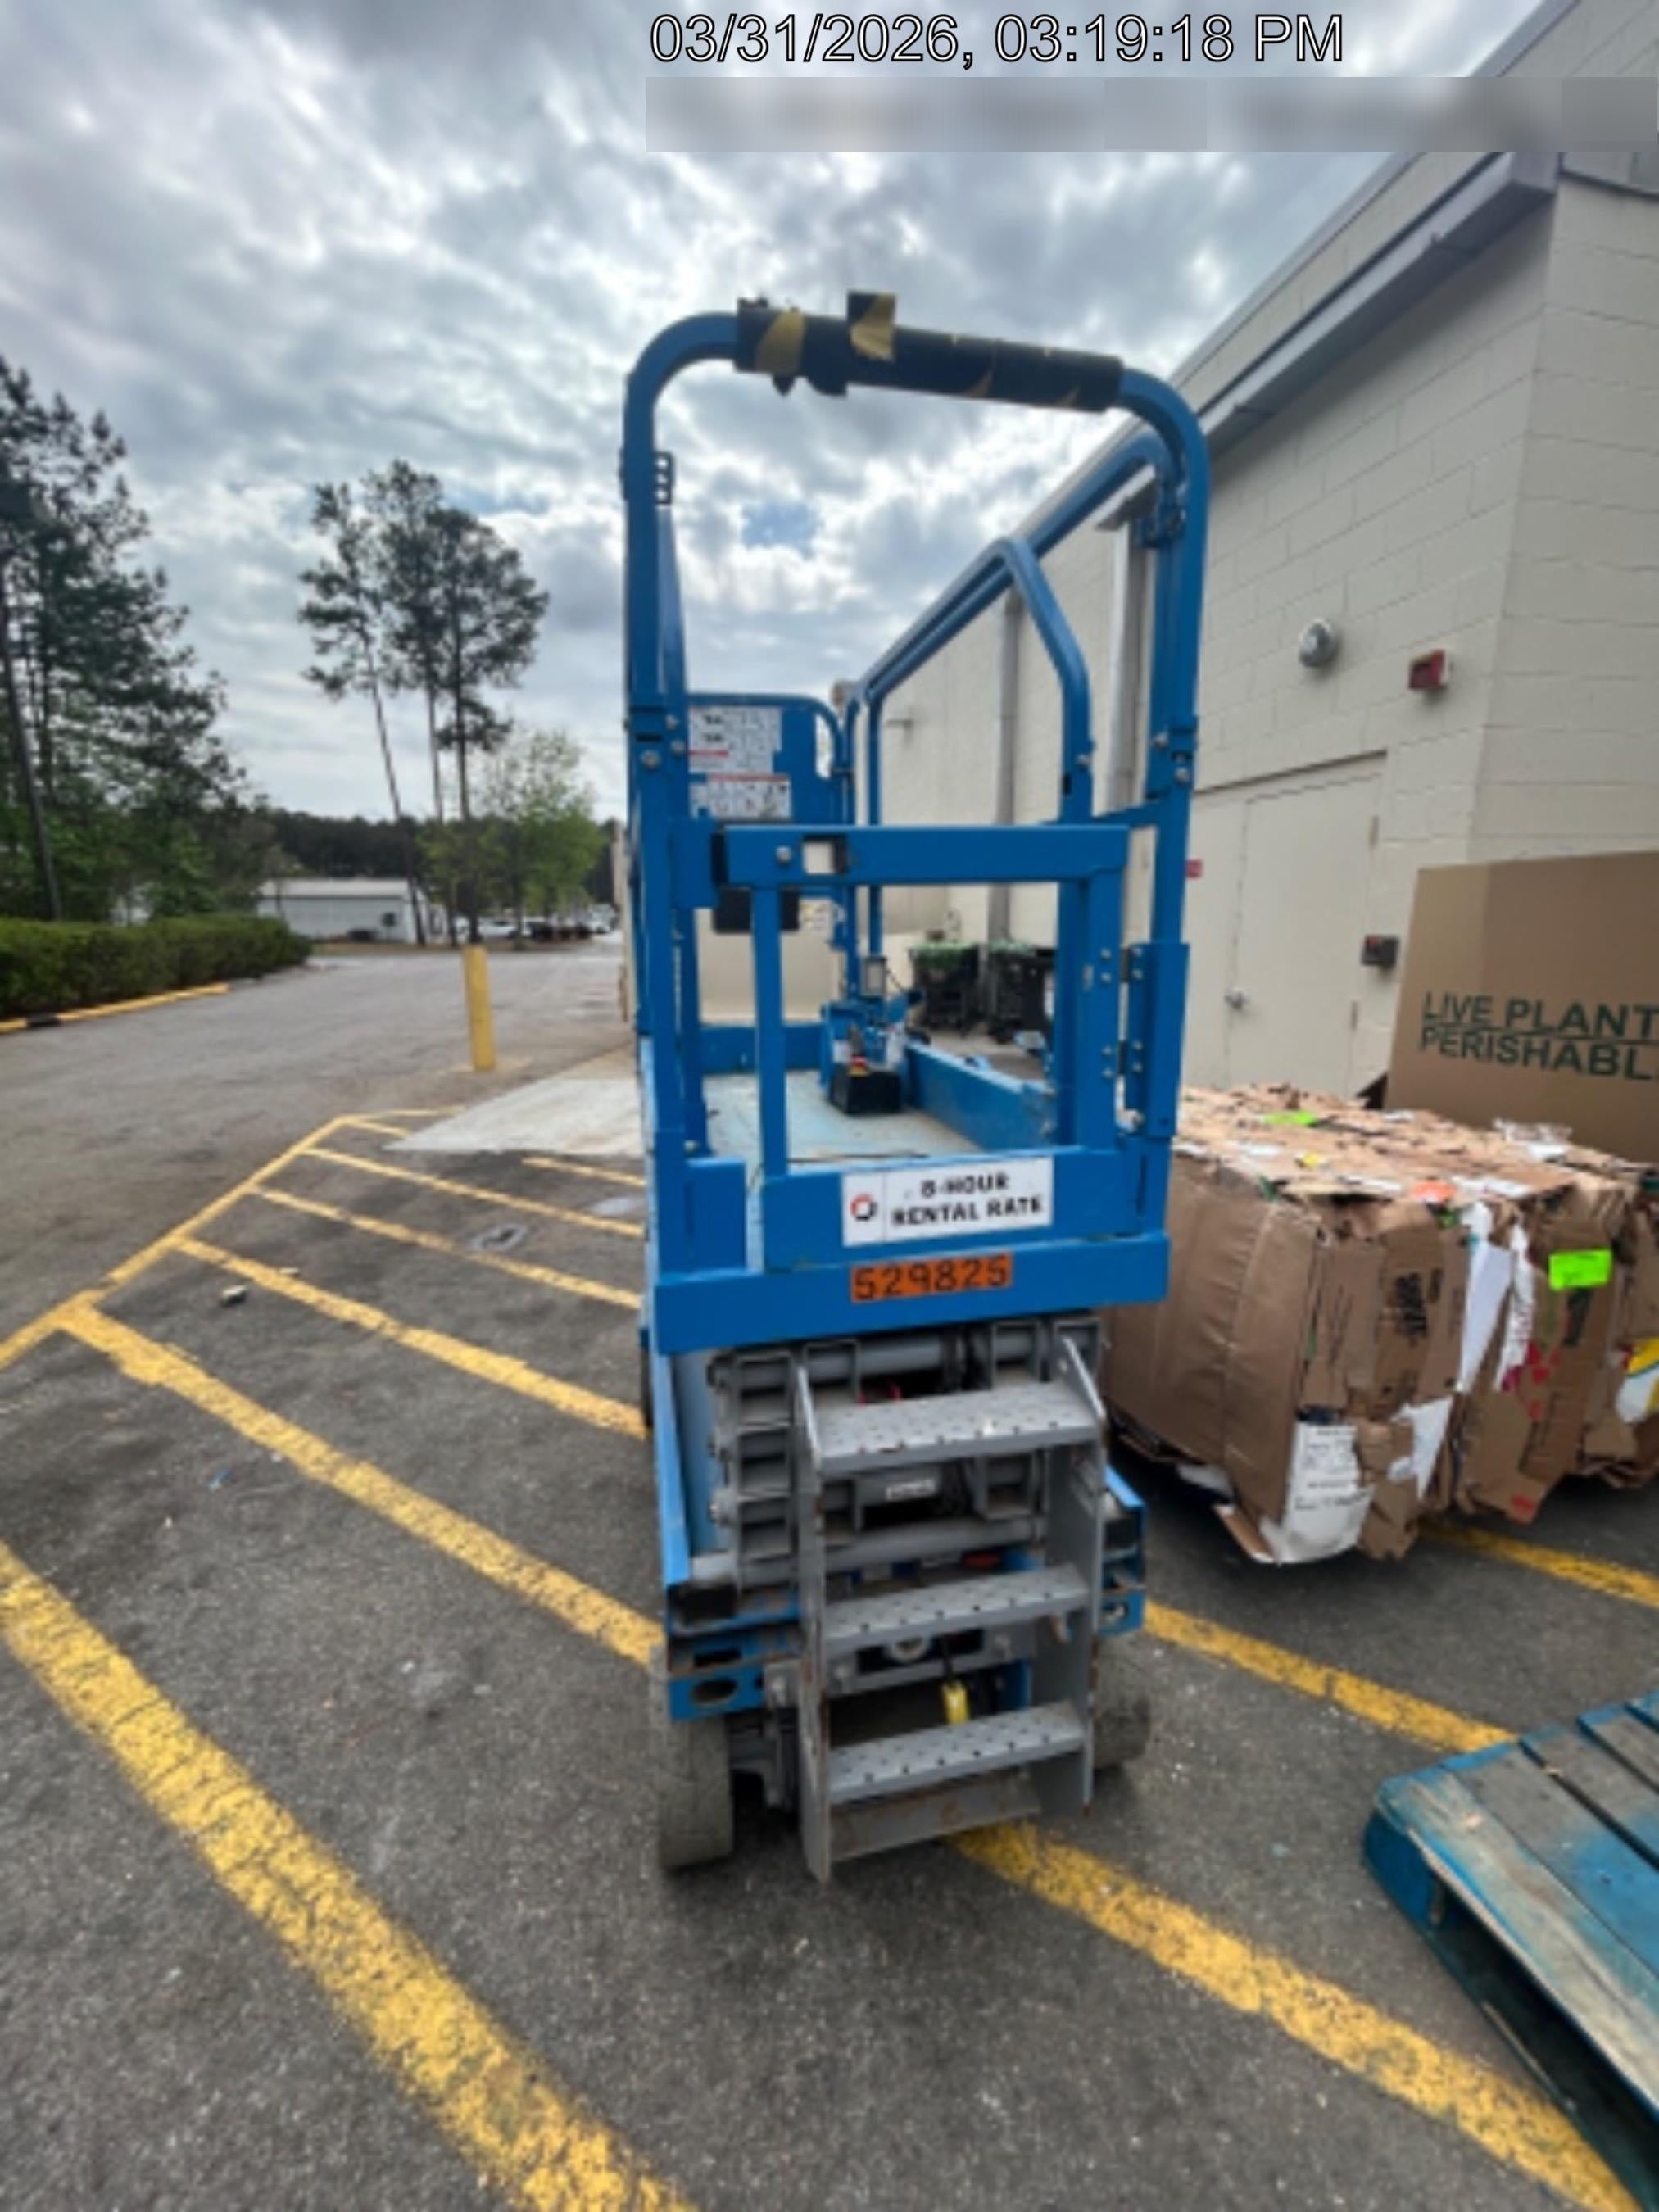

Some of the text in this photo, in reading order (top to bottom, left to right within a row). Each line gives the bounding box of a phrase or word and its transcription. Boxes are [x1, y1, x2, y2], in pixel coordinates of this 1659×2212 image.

[1423, 992, 1494, 1023] LIVE
[1420, 1026, 1659, 1081] PERISHABL
[893, 1196, 1041, 1226] RENTAL RATE
[854, 1253, 1008, 1301] 529825
